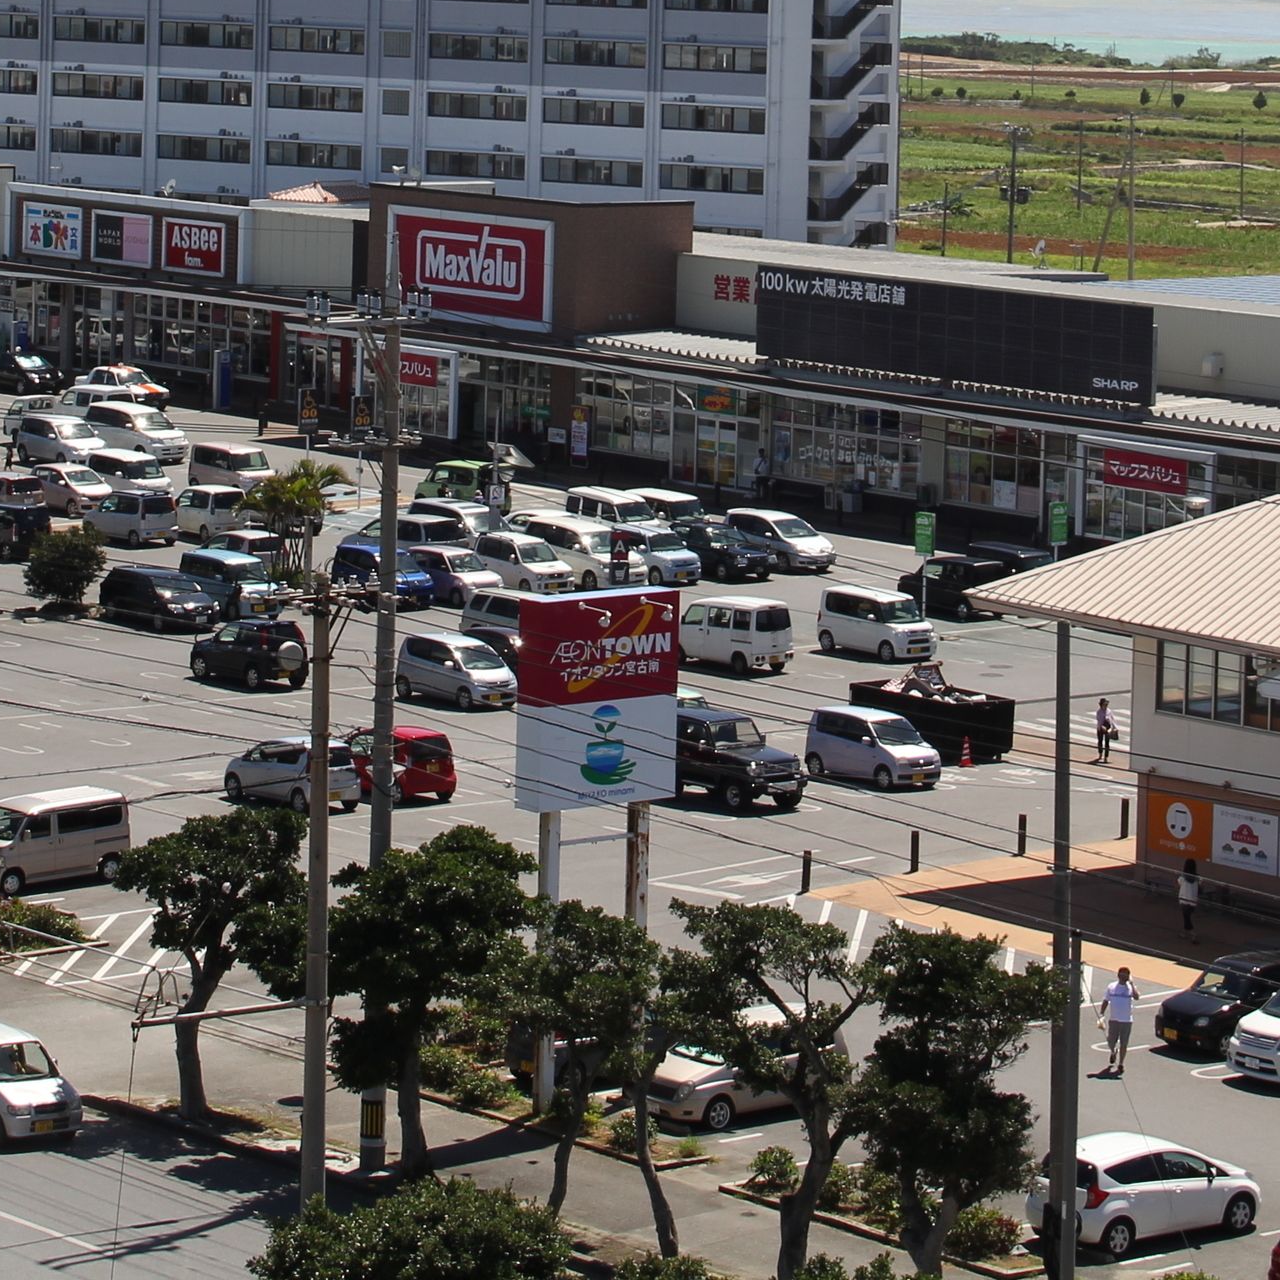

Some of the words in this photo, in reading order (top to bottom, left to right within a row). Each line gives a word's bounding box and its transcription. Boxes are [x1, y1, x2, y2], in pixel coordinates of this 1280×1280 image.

[171, 225, 218, 252] ASBee
[425, 226, 517, 288] MaxValu
[713, 273, 758, 304] 営業
[1092, 377, 1139, 391] SHARP
[1109, 460, 1181, 484] マックスバリュ
[614, 539, 626, 552] A
